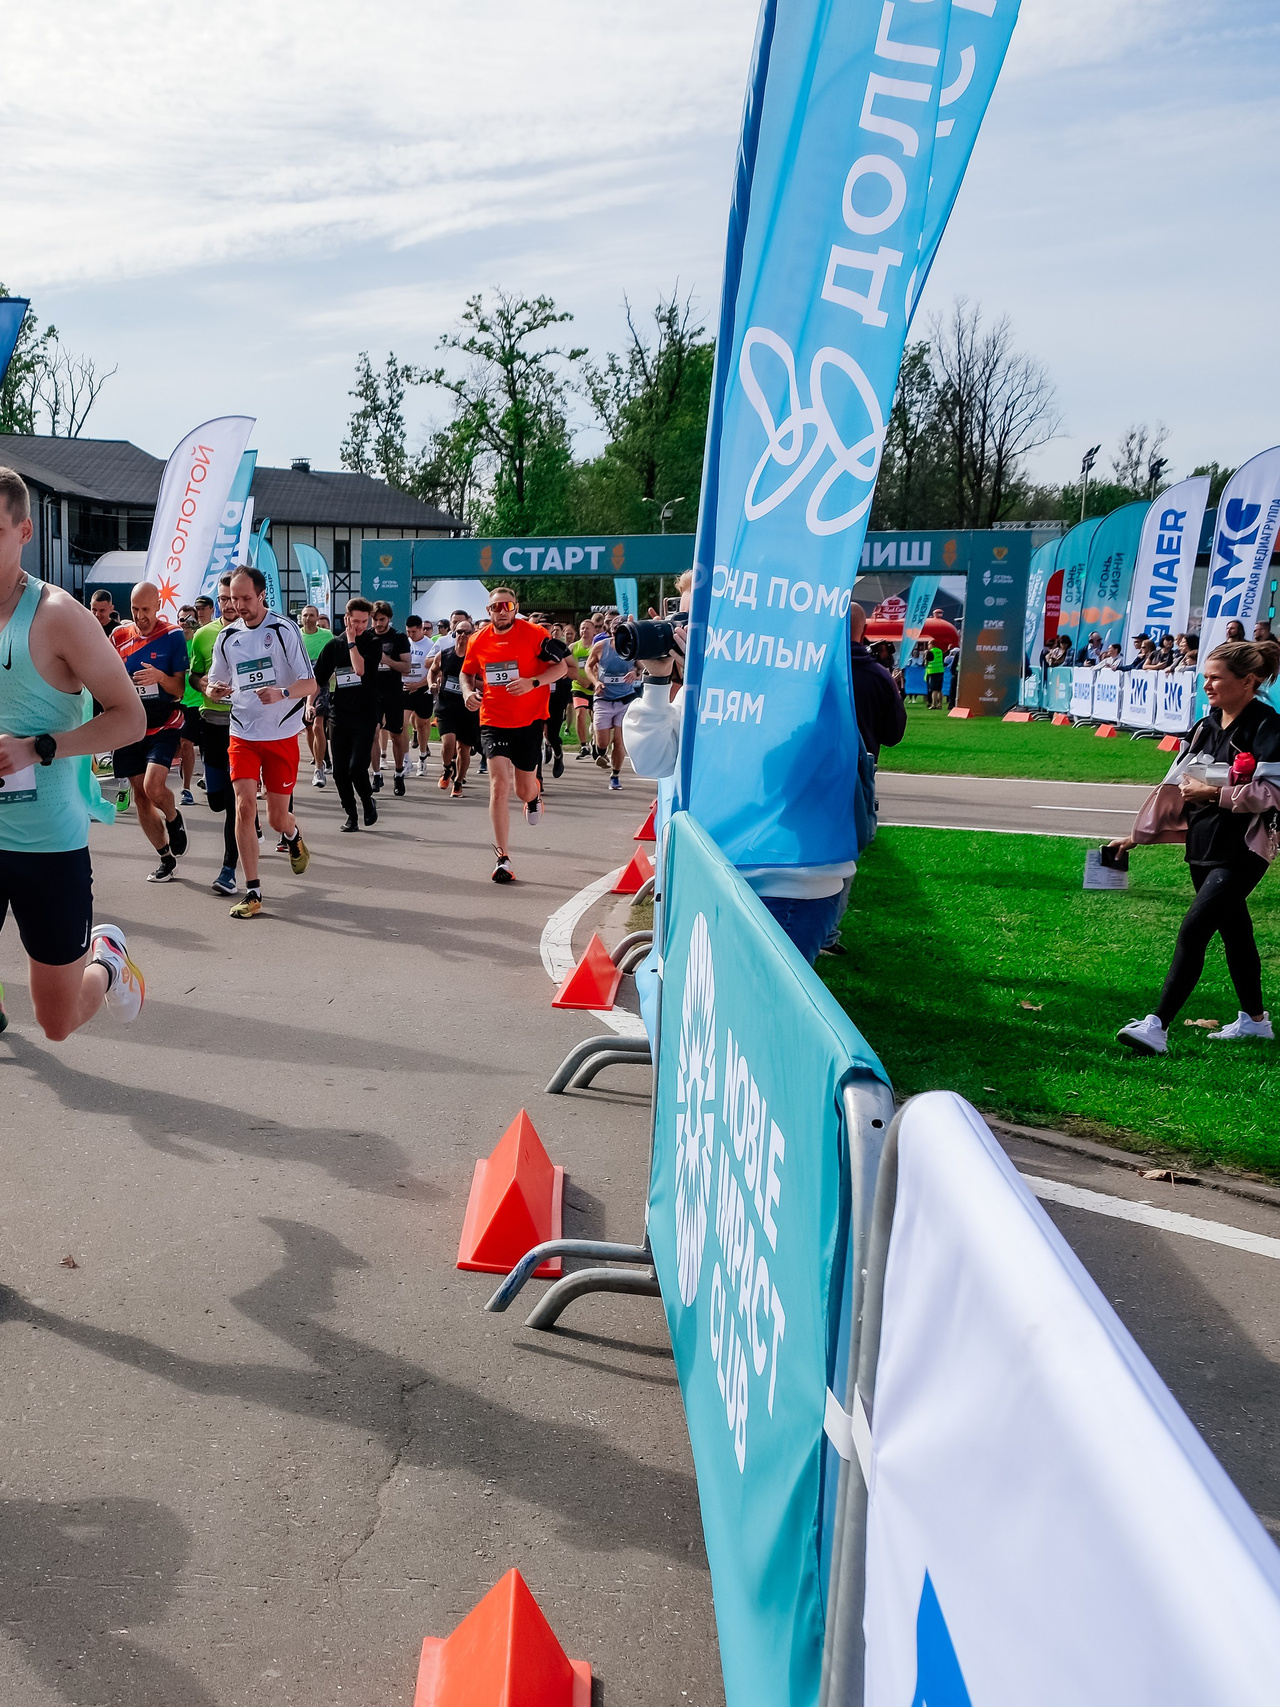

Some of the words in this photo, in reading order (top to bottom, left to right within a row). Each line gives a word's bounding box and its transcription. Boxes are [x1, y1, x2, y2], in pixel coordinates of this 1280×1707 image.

[821, 0, 946, 329] ДОЛГ
[167, 444, 215, 573] ЗОЛОТОЙ
[502, 545, 606, 571] СТАРТ
[1098, 556, 1113, 598] ОГОНЬ
[1108, 552, 1125, 601] ЖИЗНИ
[1146, 509, 1188, 618] MAER
[1241, 572, 1261, 618] РУССКАЯ
[1255, 499, 1280, 572] МЕДИАГРУППА
[766, 576, 852, 619] ПОМО
[1065, 565, 1077, 603] ОГОНЬ
[410, 648, 424, 656] AER
[249, 672, 264, 683] 59
[346, 675, 351, 683] 2
[495, 672, 508, 681] 39
[723, 1027, 786, 1255] NOBLE
[715, 1140, 787, 1420] IMPACT
[710, 1261, 749, 1475] CLUB
